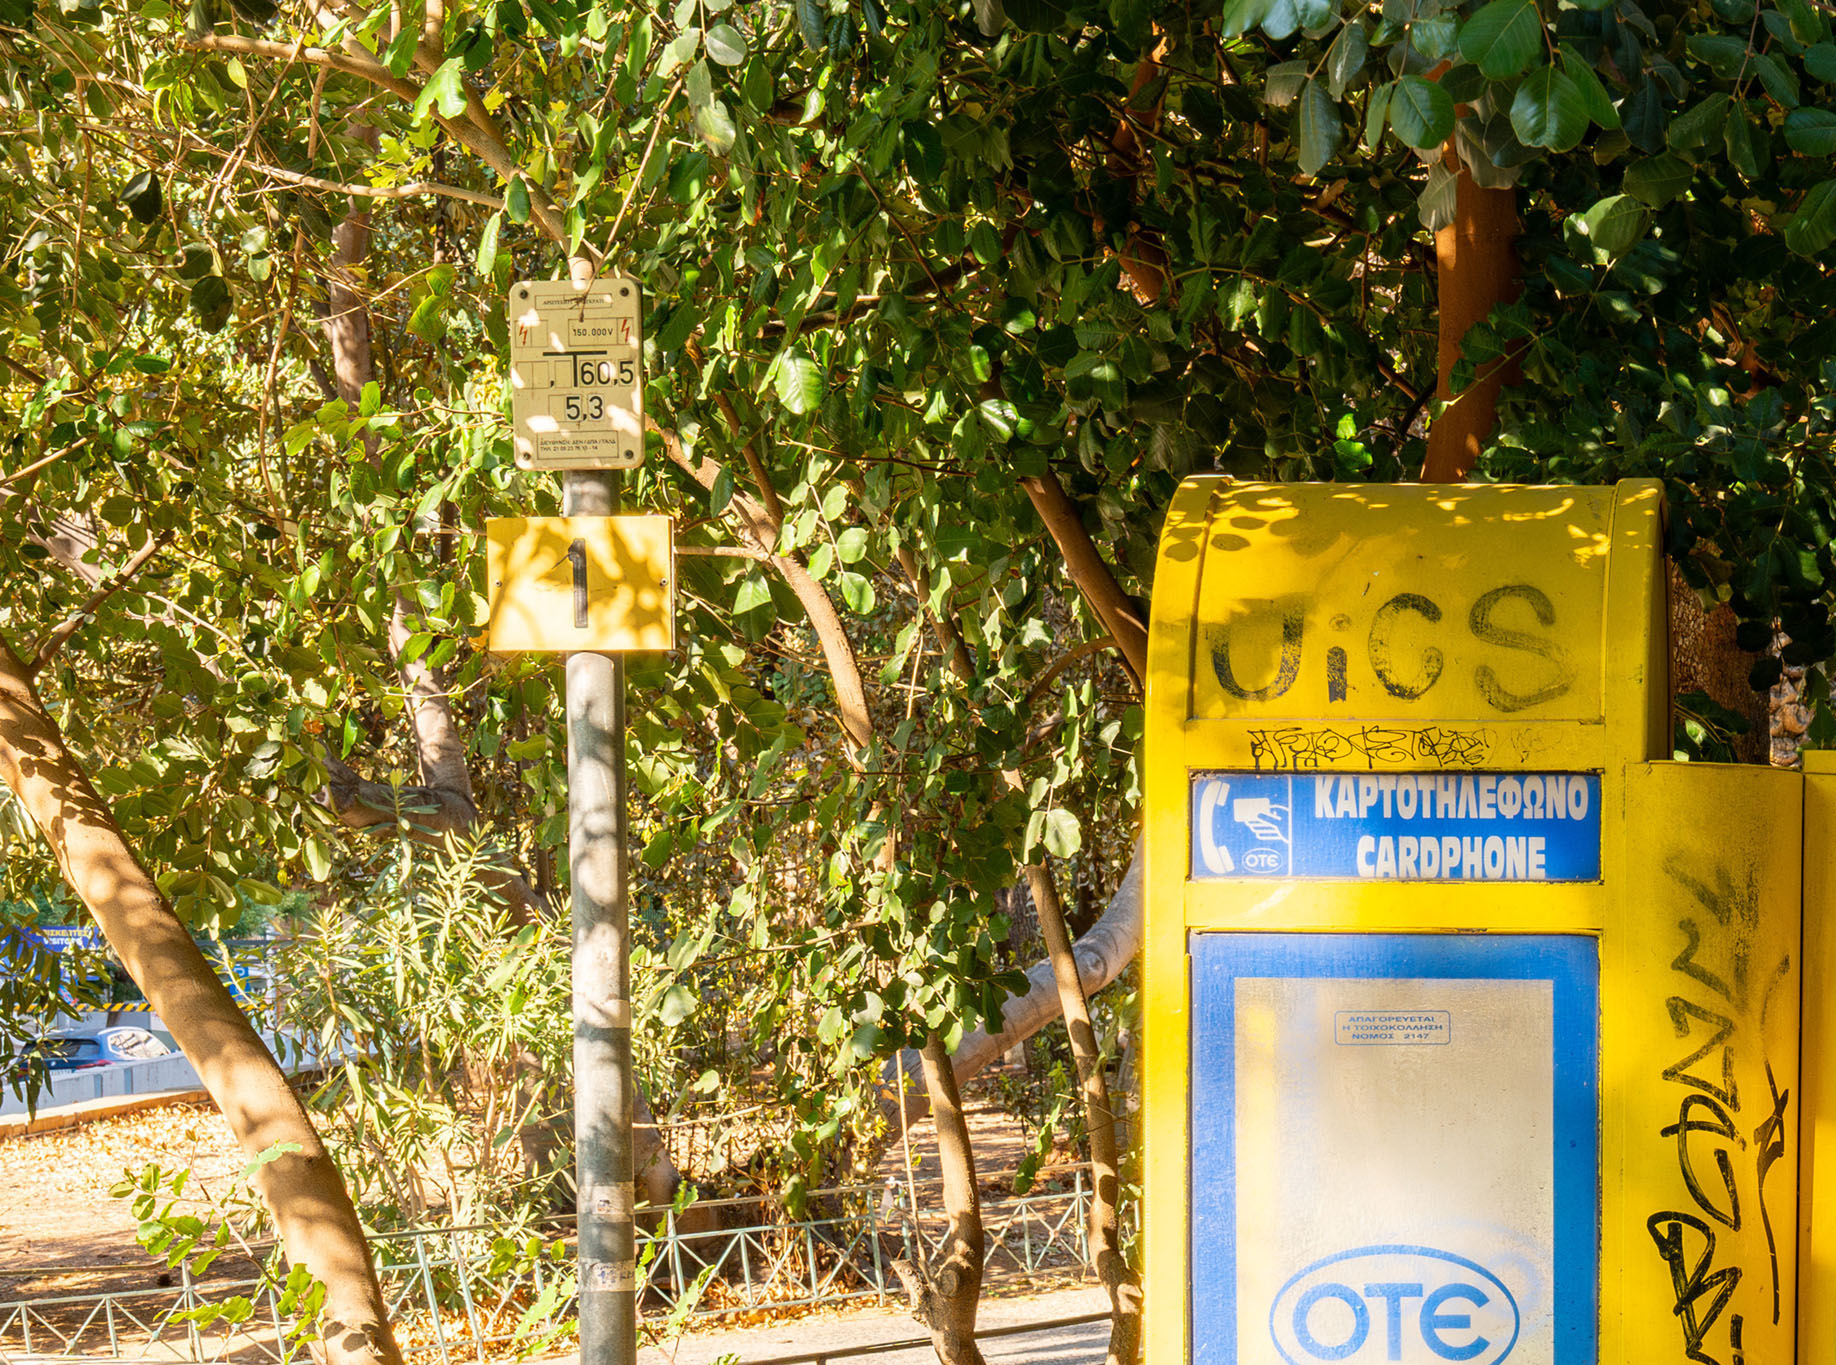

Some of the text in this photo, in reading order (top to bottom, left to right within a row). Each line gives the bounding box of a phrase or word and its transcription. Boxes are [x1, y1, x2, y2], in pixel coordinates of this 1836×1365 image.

[572, 327, 614, 337] 150.000V
[580, 360, 634, 386] 60,5
[565, 395, 604, 421] 5,3
[1314, 775, 1589, 821] ΚΑΡΤΟΤΗΛΕΦΩΝΟ
[1356, 834, 1546, 879] CARDPHONE
[1341, 1024, 1351, 1032] Η
[1348, 1015, 1435, 1023] ΑΠΑΓΟΡΕΥΕΤΑΙ
[1351, 1032, 1395, 1040] ΝΟΜΟΣ
